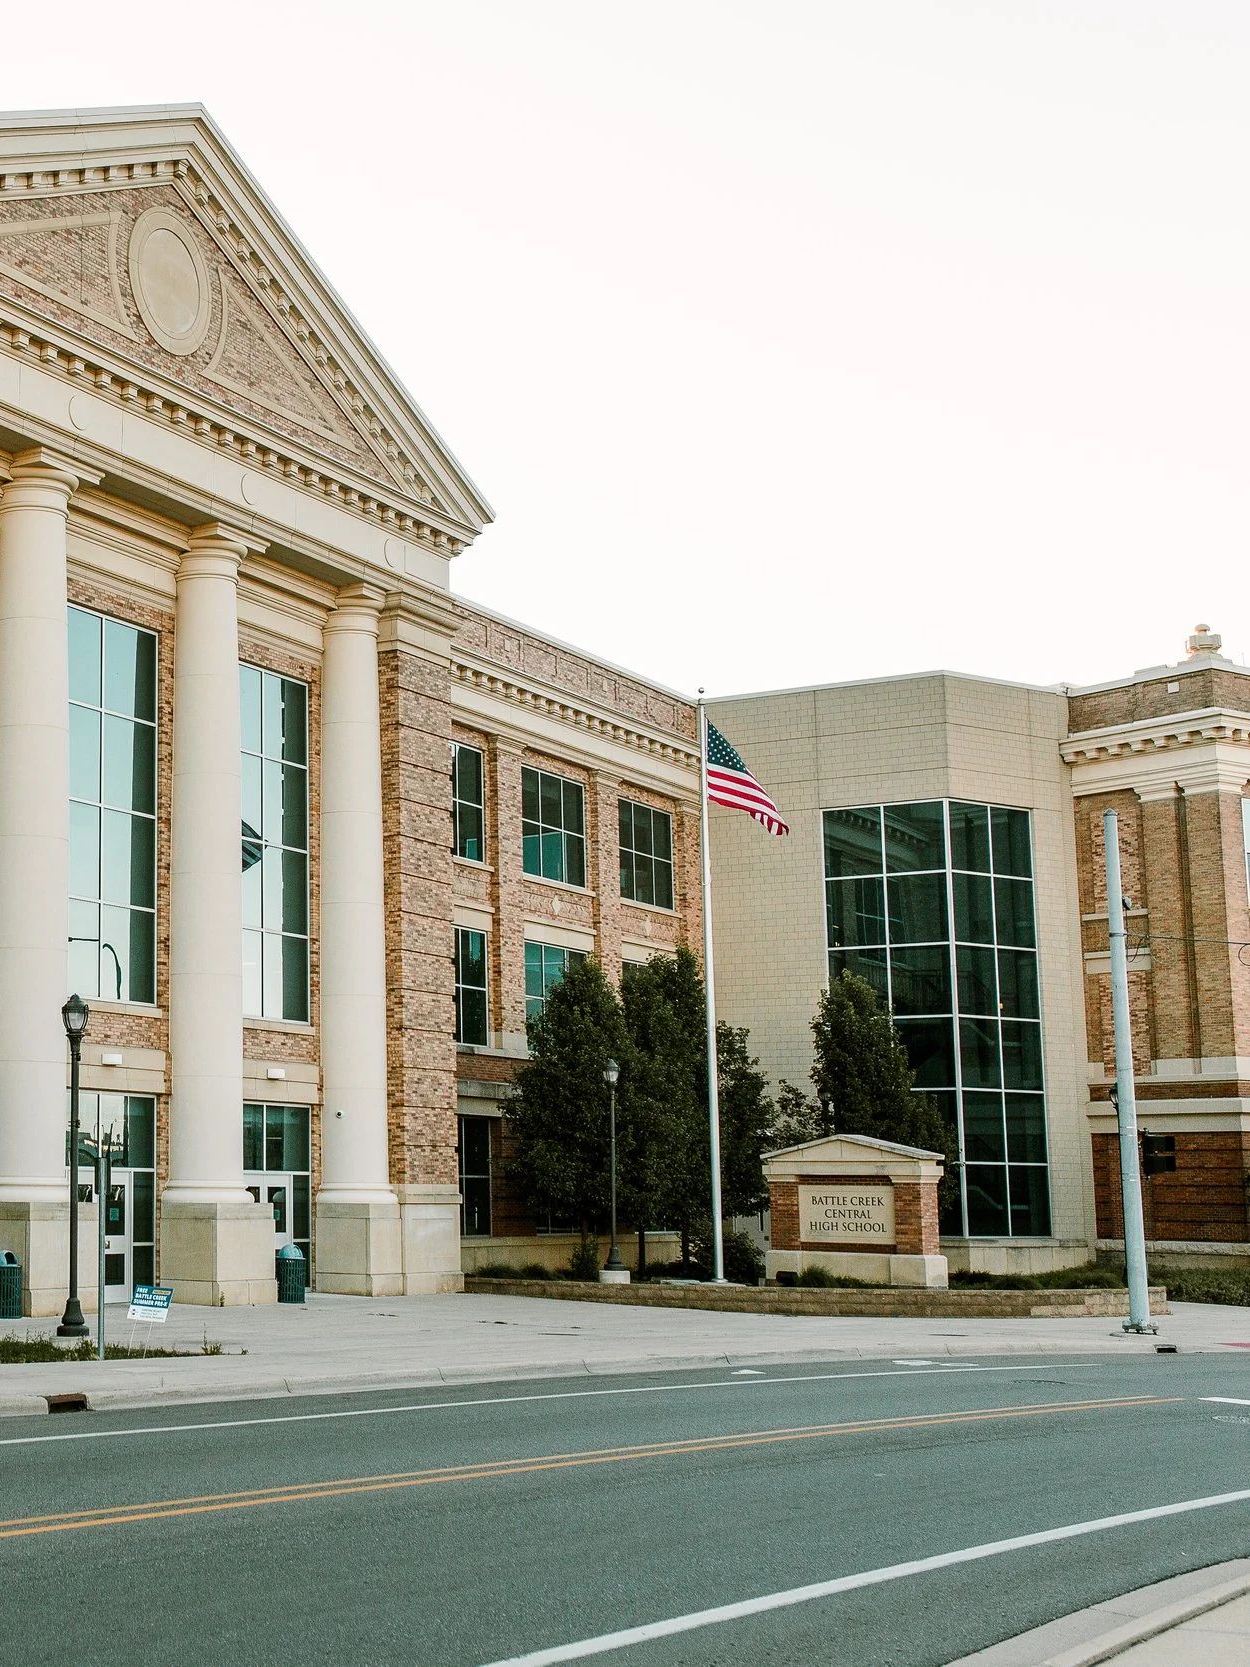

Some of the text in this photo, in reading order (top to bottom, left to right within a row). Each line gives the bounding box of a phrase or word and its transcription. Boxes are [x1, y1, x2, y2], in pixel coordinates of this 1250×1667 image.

[811, 1195, 885, 1206] BATTLE CREEK
[824, 1209, 872, 1219] CENTRAL
[809, 1221, 887, 1232] HIGH SCHOOL
